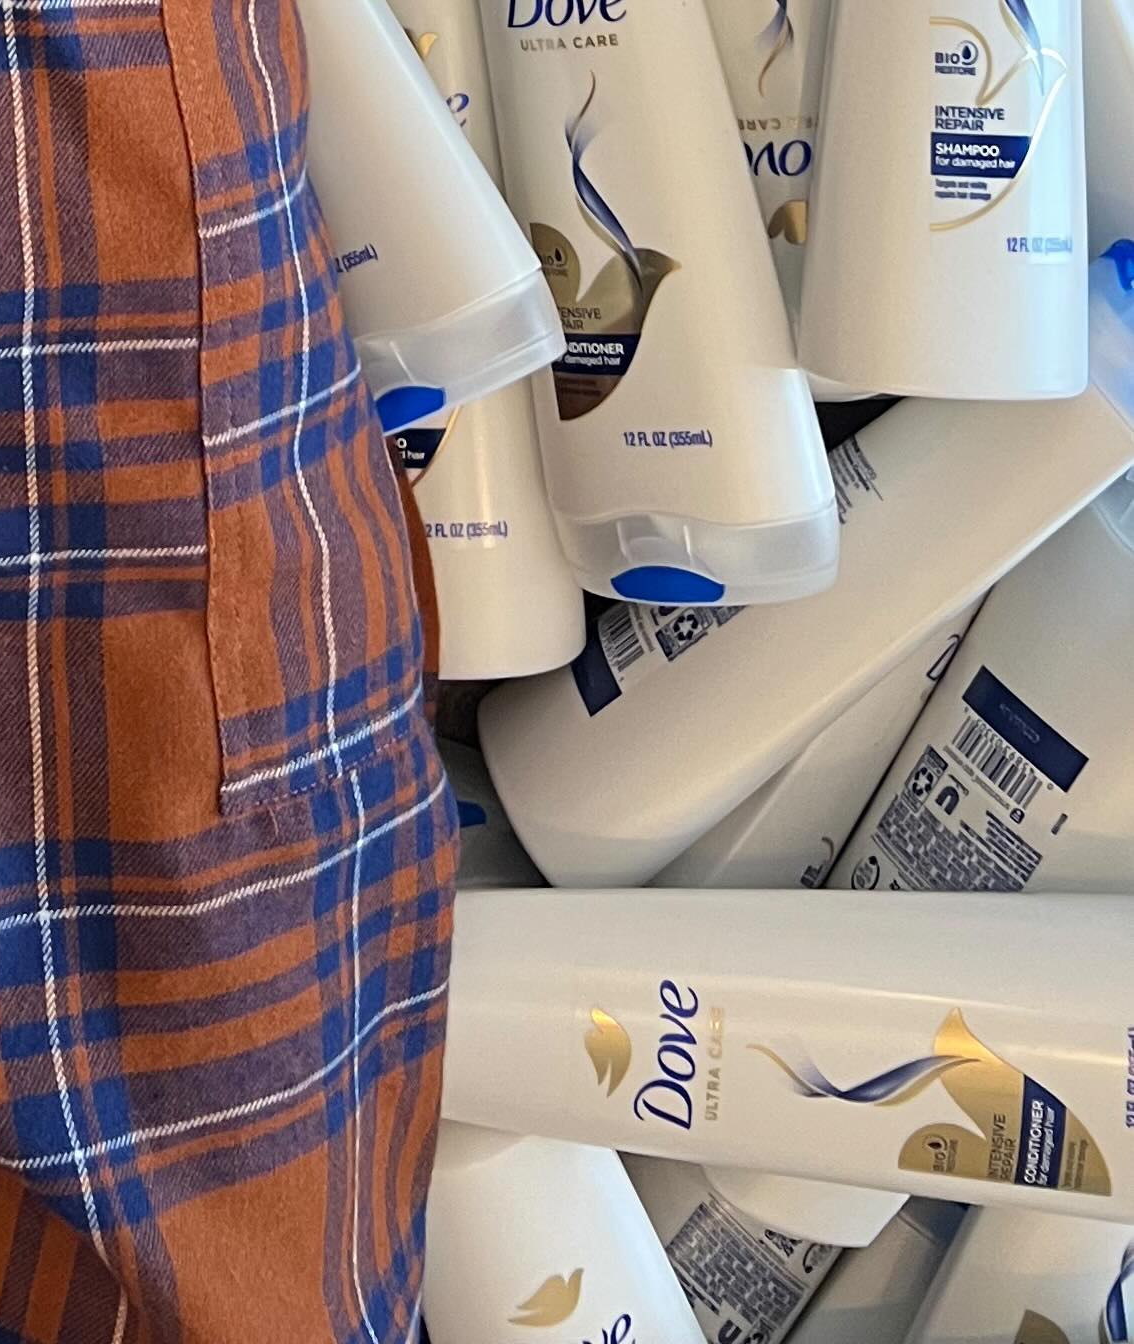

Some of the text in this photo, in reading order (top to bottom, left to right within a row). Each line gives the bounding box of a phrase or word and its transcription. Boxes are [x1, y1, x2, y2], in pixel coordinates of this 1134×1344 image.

[573, 32, 619, 48] CARE
[935, 52, 960, 64] BIO
[935, 105, 1005, 120] INTENSIVE
[935, 118, 984, 132] REPAIR
[936, 143, 1000, 157] SHAMPOO
[936, 156, 1016, 170] for damaged hair
[1006, 238, 1018, 252] 12
[1019, 238, 1030, 252] FL
[624, 431, 667, 446] 12 FL OZ
[435, 522, 464, 538] FL OZ
[633, 979, 698, 1130] Dove
[704, 1061, 724, 1122] ULTRA
[1024, 1099, 1044, 1184] CONDITIONER
